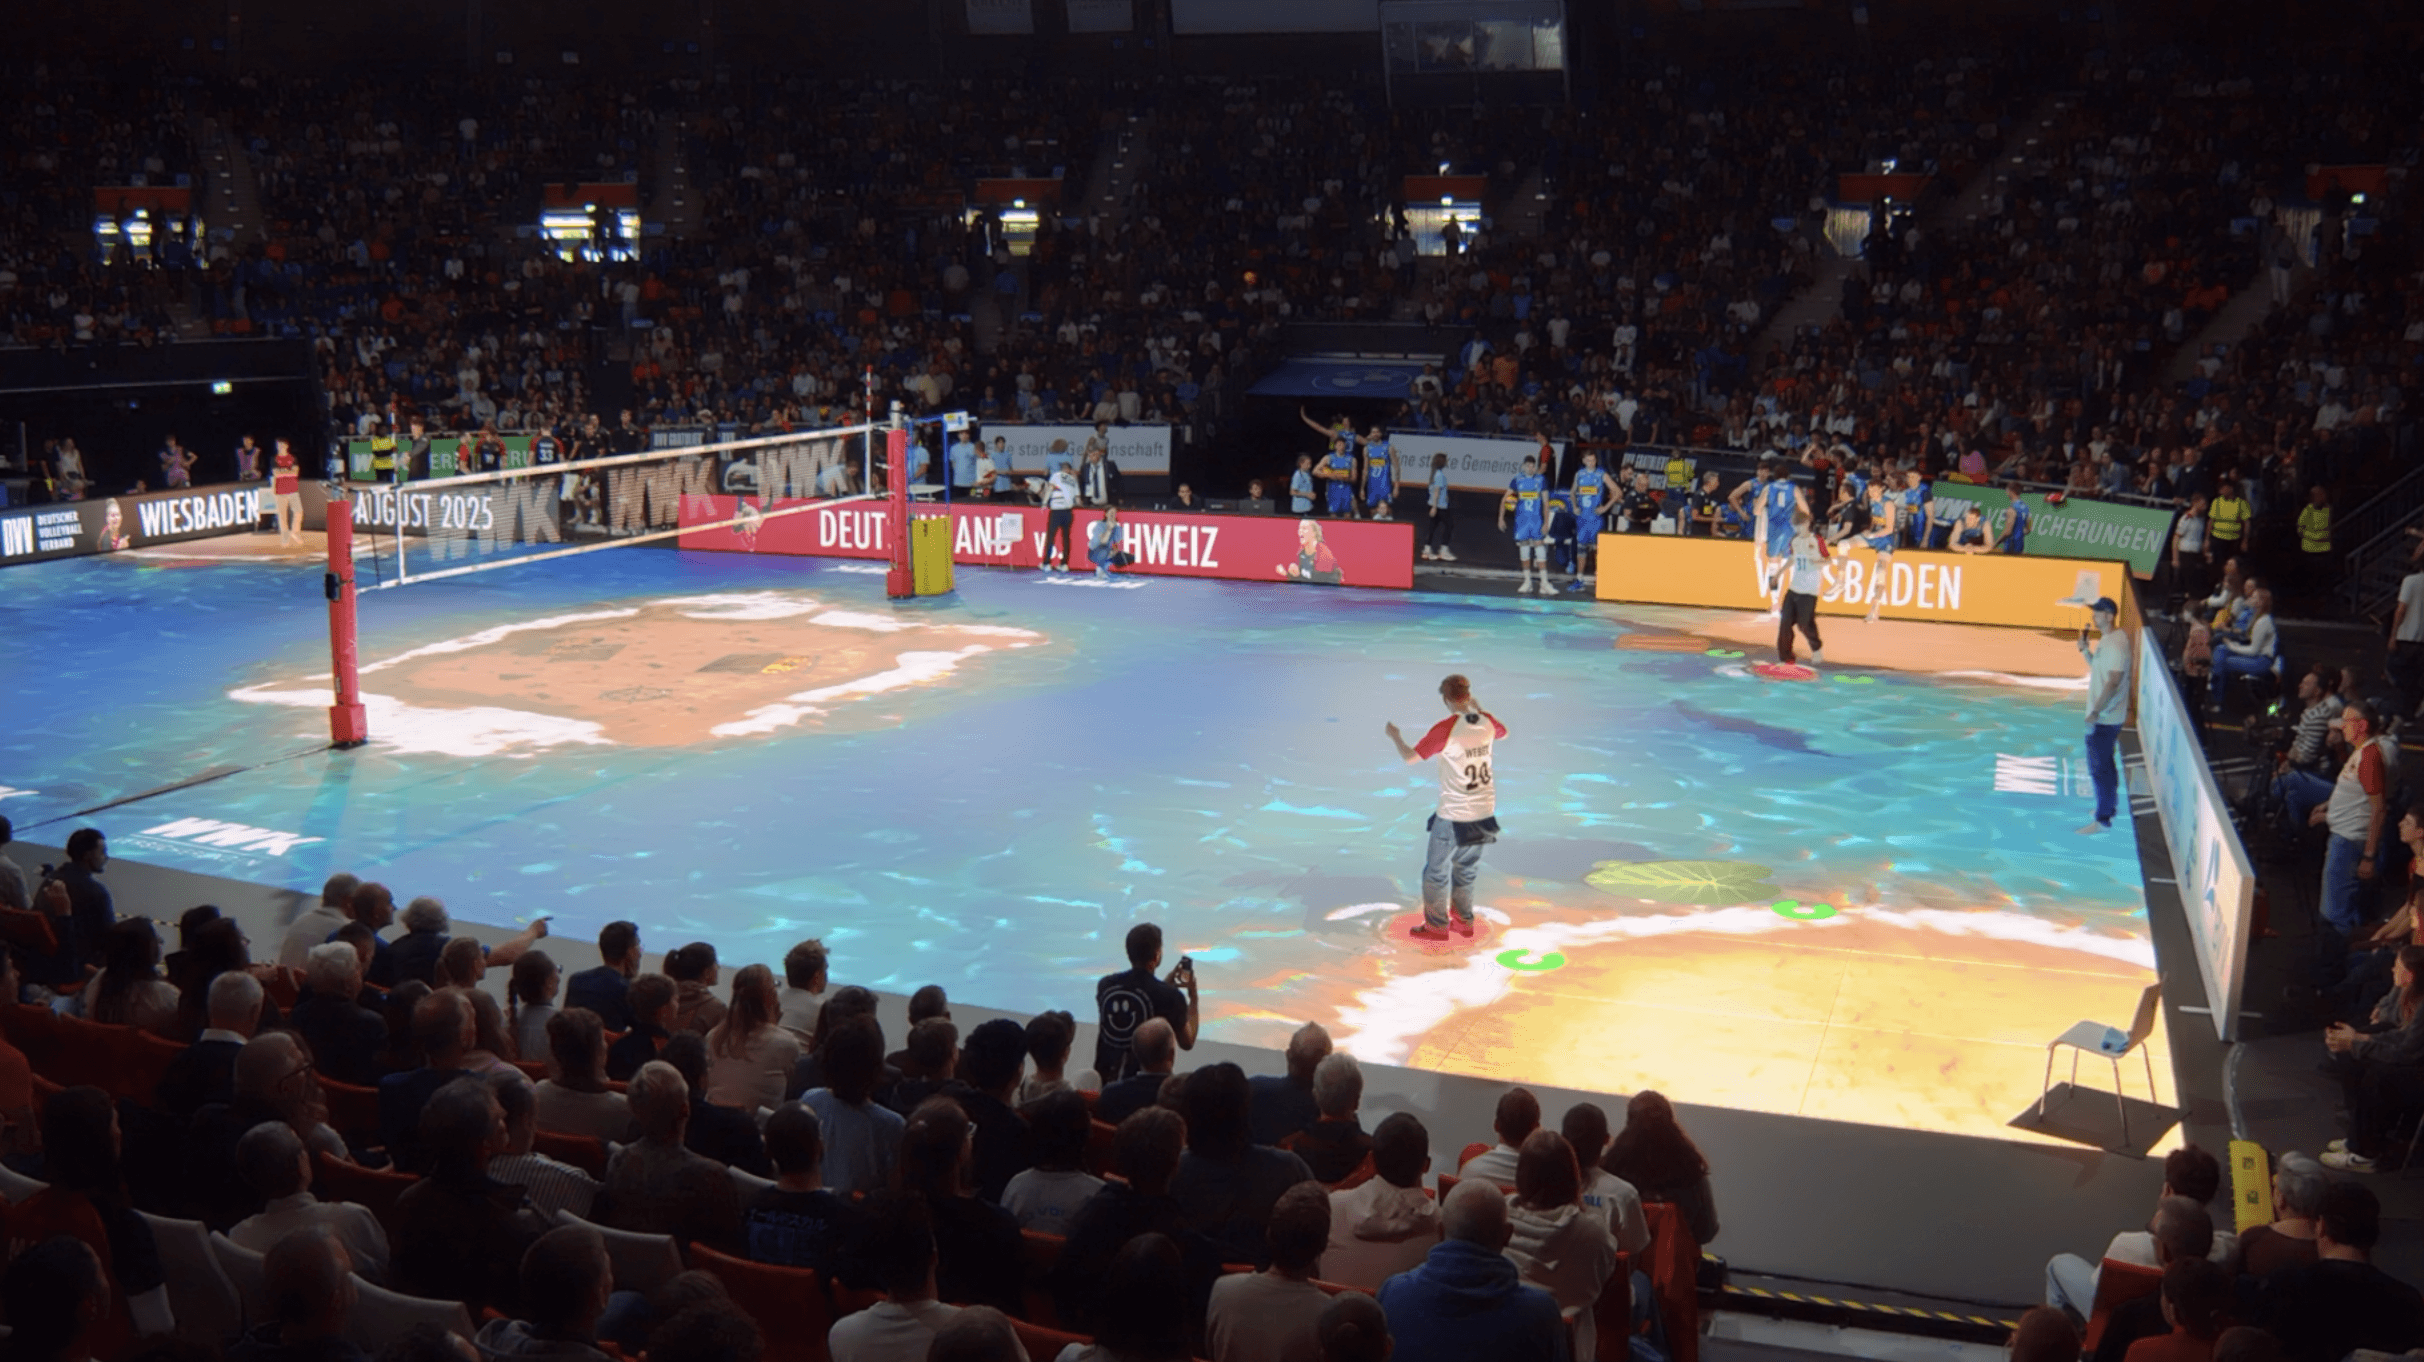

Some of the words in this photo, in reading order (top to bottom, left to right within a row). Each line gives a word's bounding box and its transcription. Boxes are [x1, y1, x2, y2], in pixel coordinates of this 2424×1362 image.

[1067, 441, 1164, 457] Geinschaft
[138, 489, 260, 537] WIESBADEN
[354, 491, 431, 527] AUGUST
[439, 495, 493, 530] 2025
[820, 510, 1012, 556] DEUTAND
[1986, 507, 2163, 554] VEICHERUNGEN
[1754, 556, 1962, 610] WSBADEN
